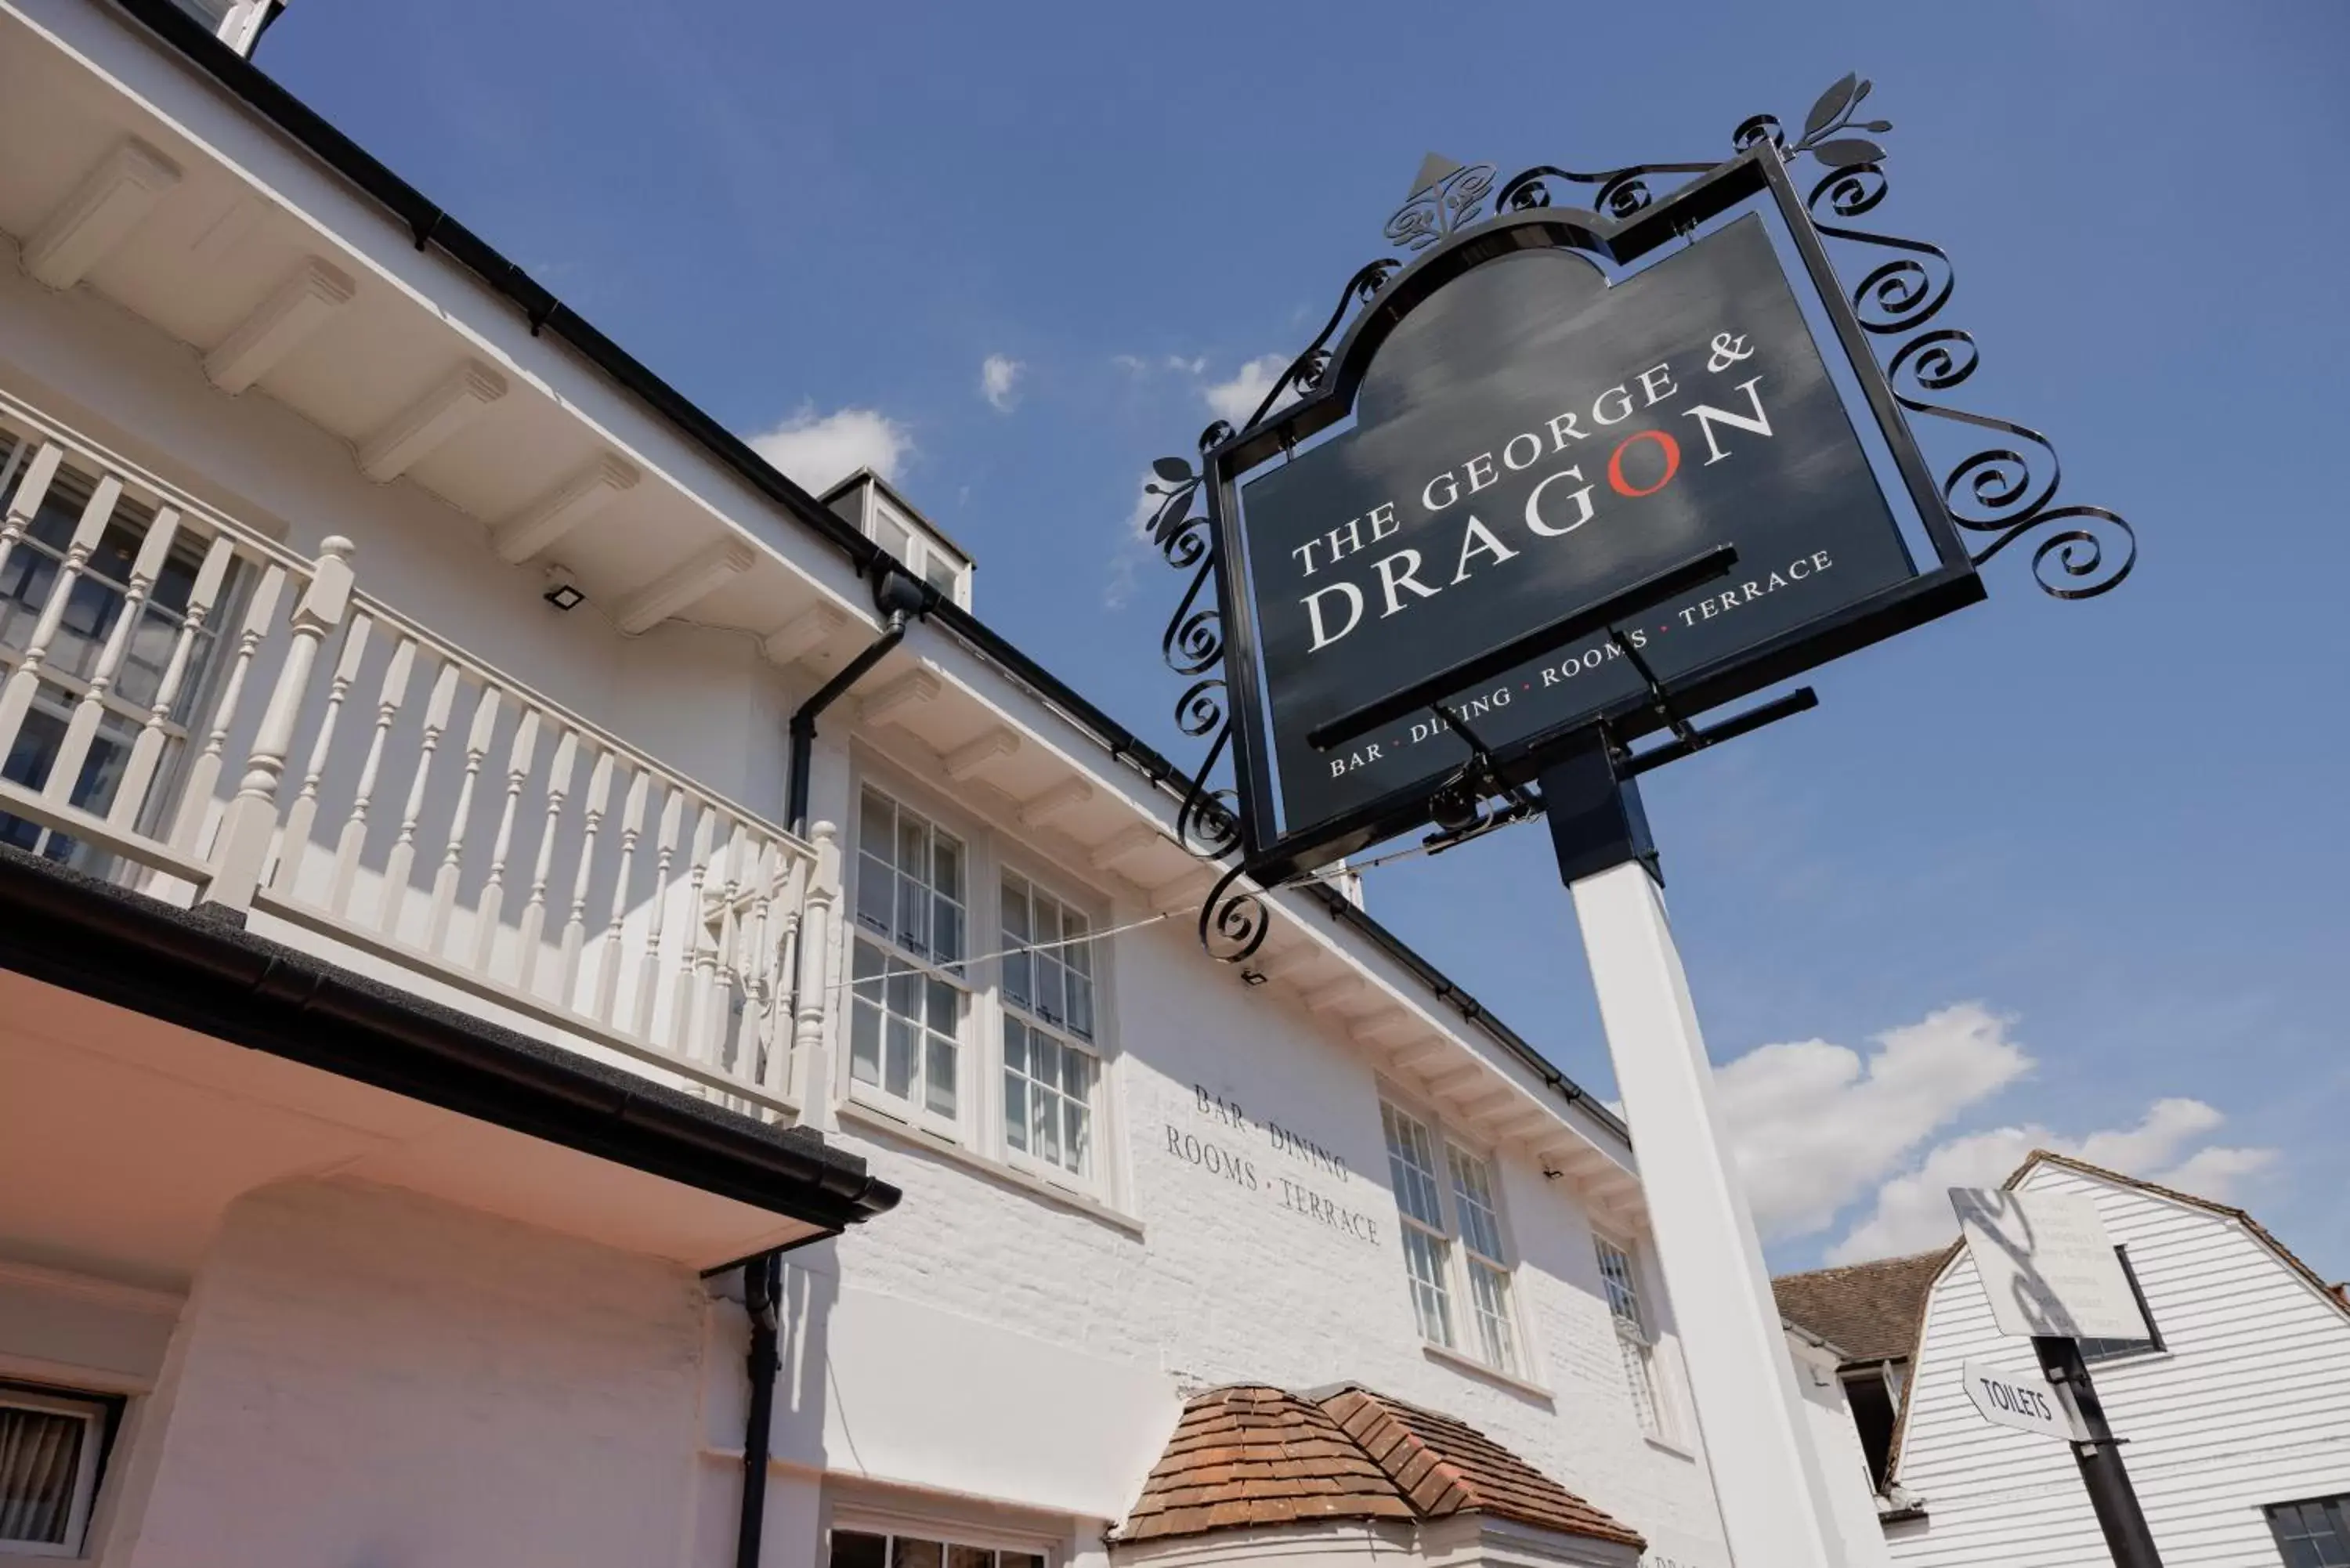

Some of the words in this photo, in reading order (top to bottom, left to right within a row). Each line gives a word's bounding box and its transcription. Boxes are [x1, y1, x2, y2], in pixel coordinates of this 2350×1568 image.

[1292, 502, 1401, 576] THE
[1421, 363, 1678, 511] GEORGE
[1706, 332, 1755, 372] &
[1300, 375, 1773, 652] DRAGON
[1330, 742, 1383, 778] BAR
[1679, 551, 1833, 627] TERRACE
[1166, 1125, 1257, 1191] ROOMS
[1279, 1177, 1380, 1246] TERRACE
[1195, 1084, 1246, 1133] BAR
[1269, 1121, 1348, 1183] DINING
[1979, 1378, 2052, 1421] TOILETS
